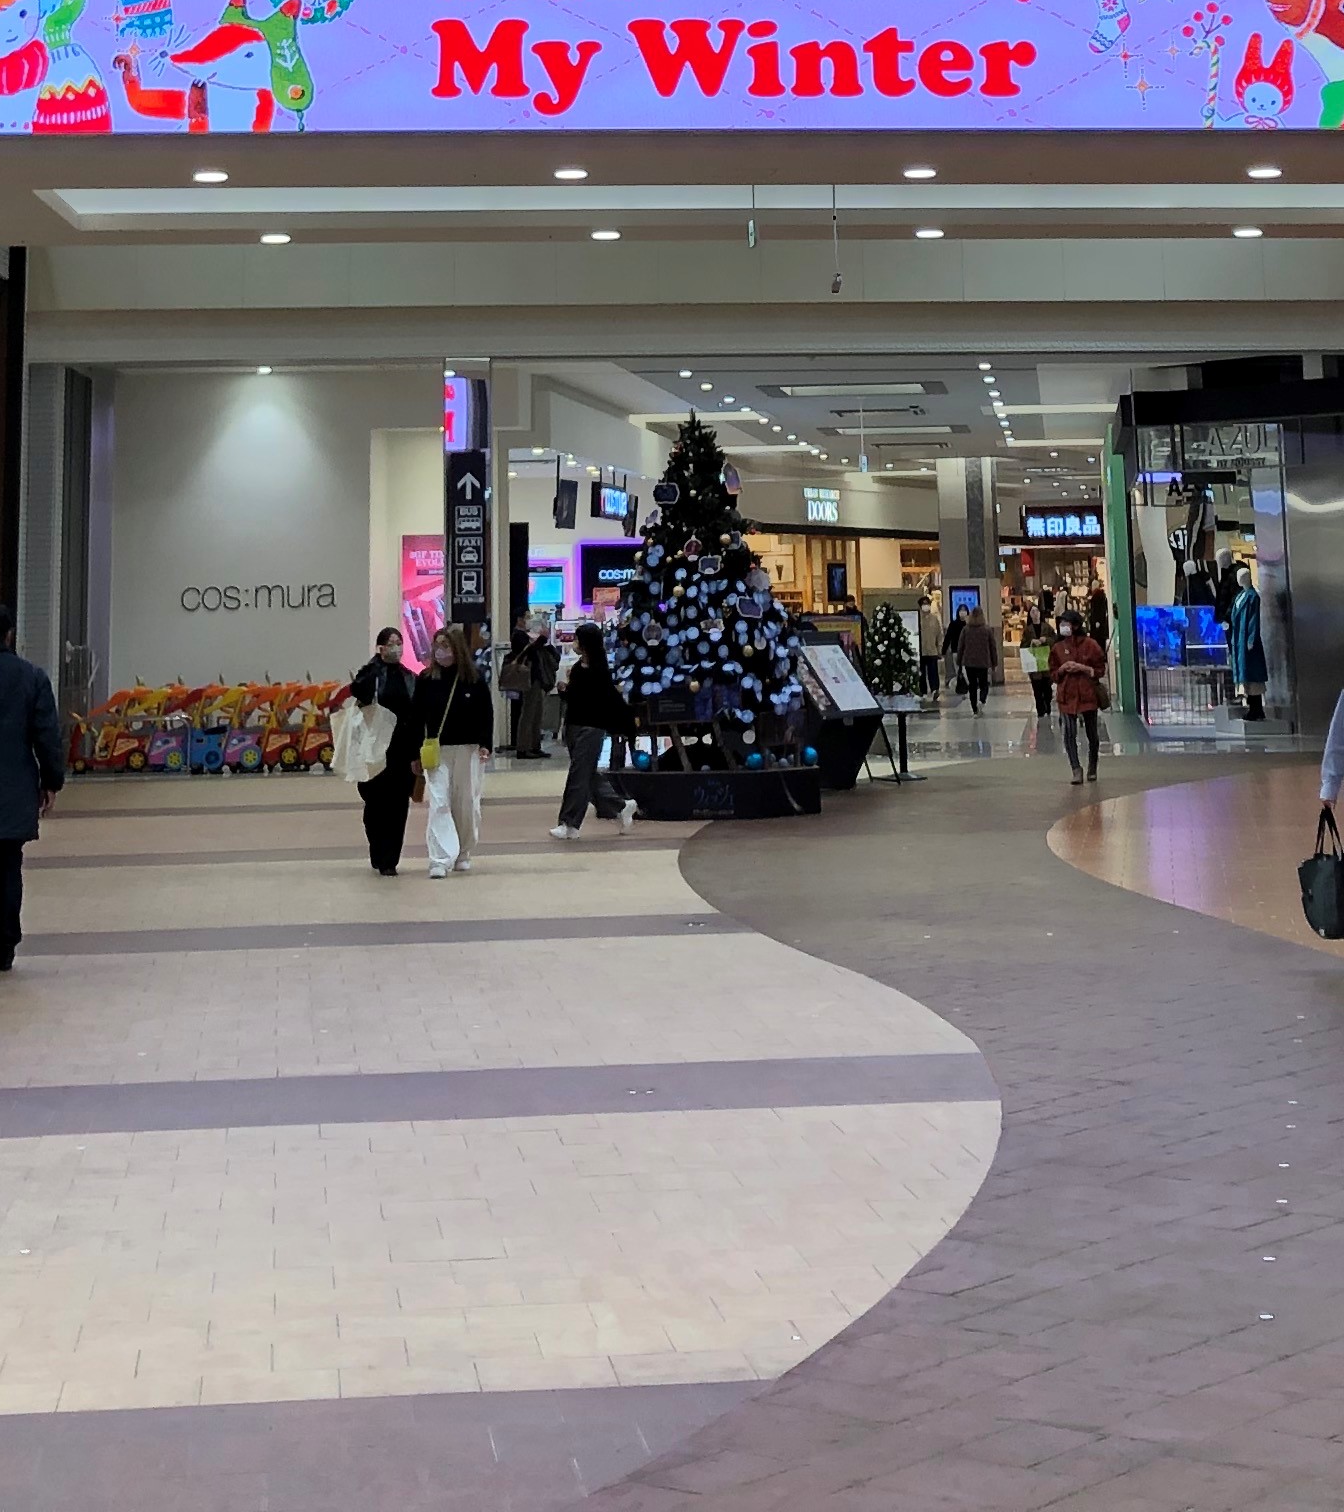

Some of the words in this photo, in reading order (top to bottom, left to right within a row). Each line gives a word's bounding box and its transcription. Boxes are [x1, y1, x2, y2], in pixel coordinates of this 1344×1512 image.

[431, 18, 603, 117] My
[627, 18, 1037, 98] Winter
[1204, 422, 1278, 456] AZUL
[459, 506, 479, 516] BUS
[807, 499, 839, 522] DOORS
[1026, 514, 1102, 538] 無印良品
[459, 539, 481, 547] TAXI
[179, 577, 337, 613] cos:mura
